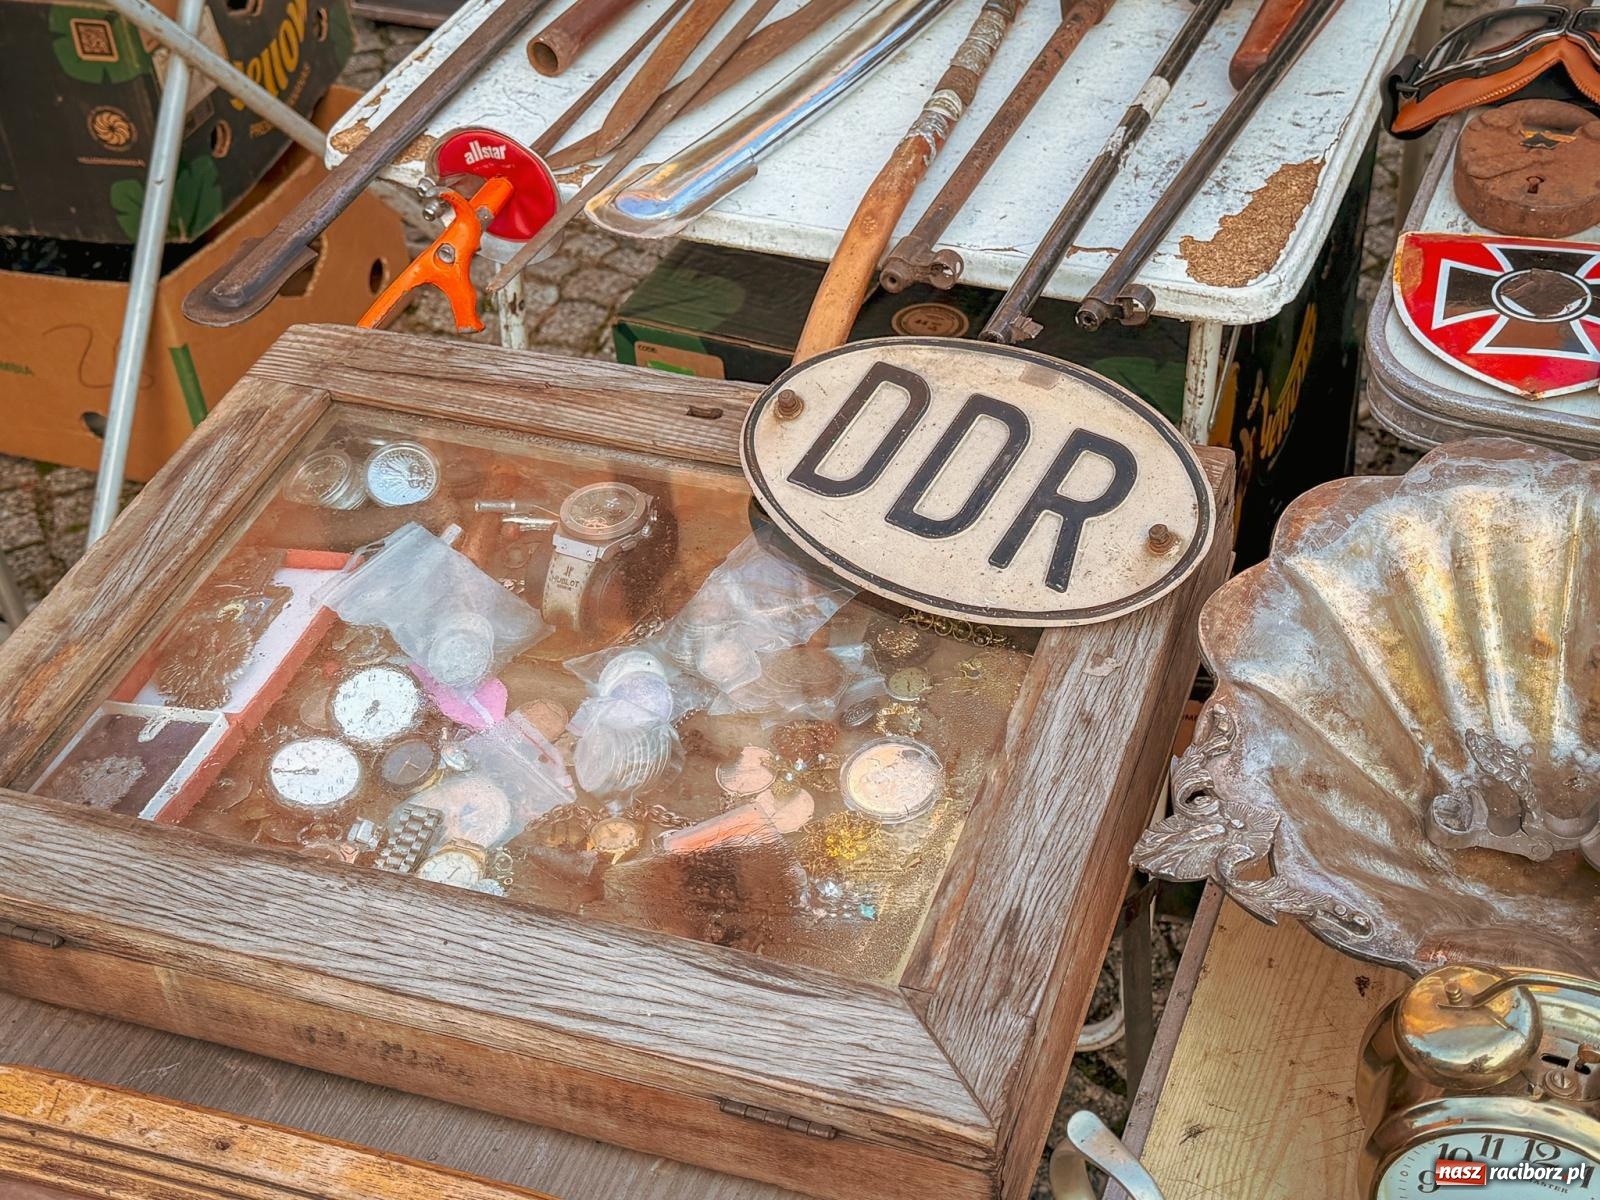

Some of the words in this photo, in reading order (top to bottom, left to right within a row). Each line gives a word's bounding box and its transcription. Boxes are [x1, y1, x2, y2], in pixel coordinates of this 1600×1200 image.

[230, 0, 308, 111] ello
[463, 140, 507, 165] allstar
[787, 361, 1138, 593] DDR
[1478, 1134, 1505, 1161] 11
[1522, 1138, 1562, 1168] 12
[1417, 1170, 1441, 1193] 9
[1526, 1178, 1568, 1194] ASTER
